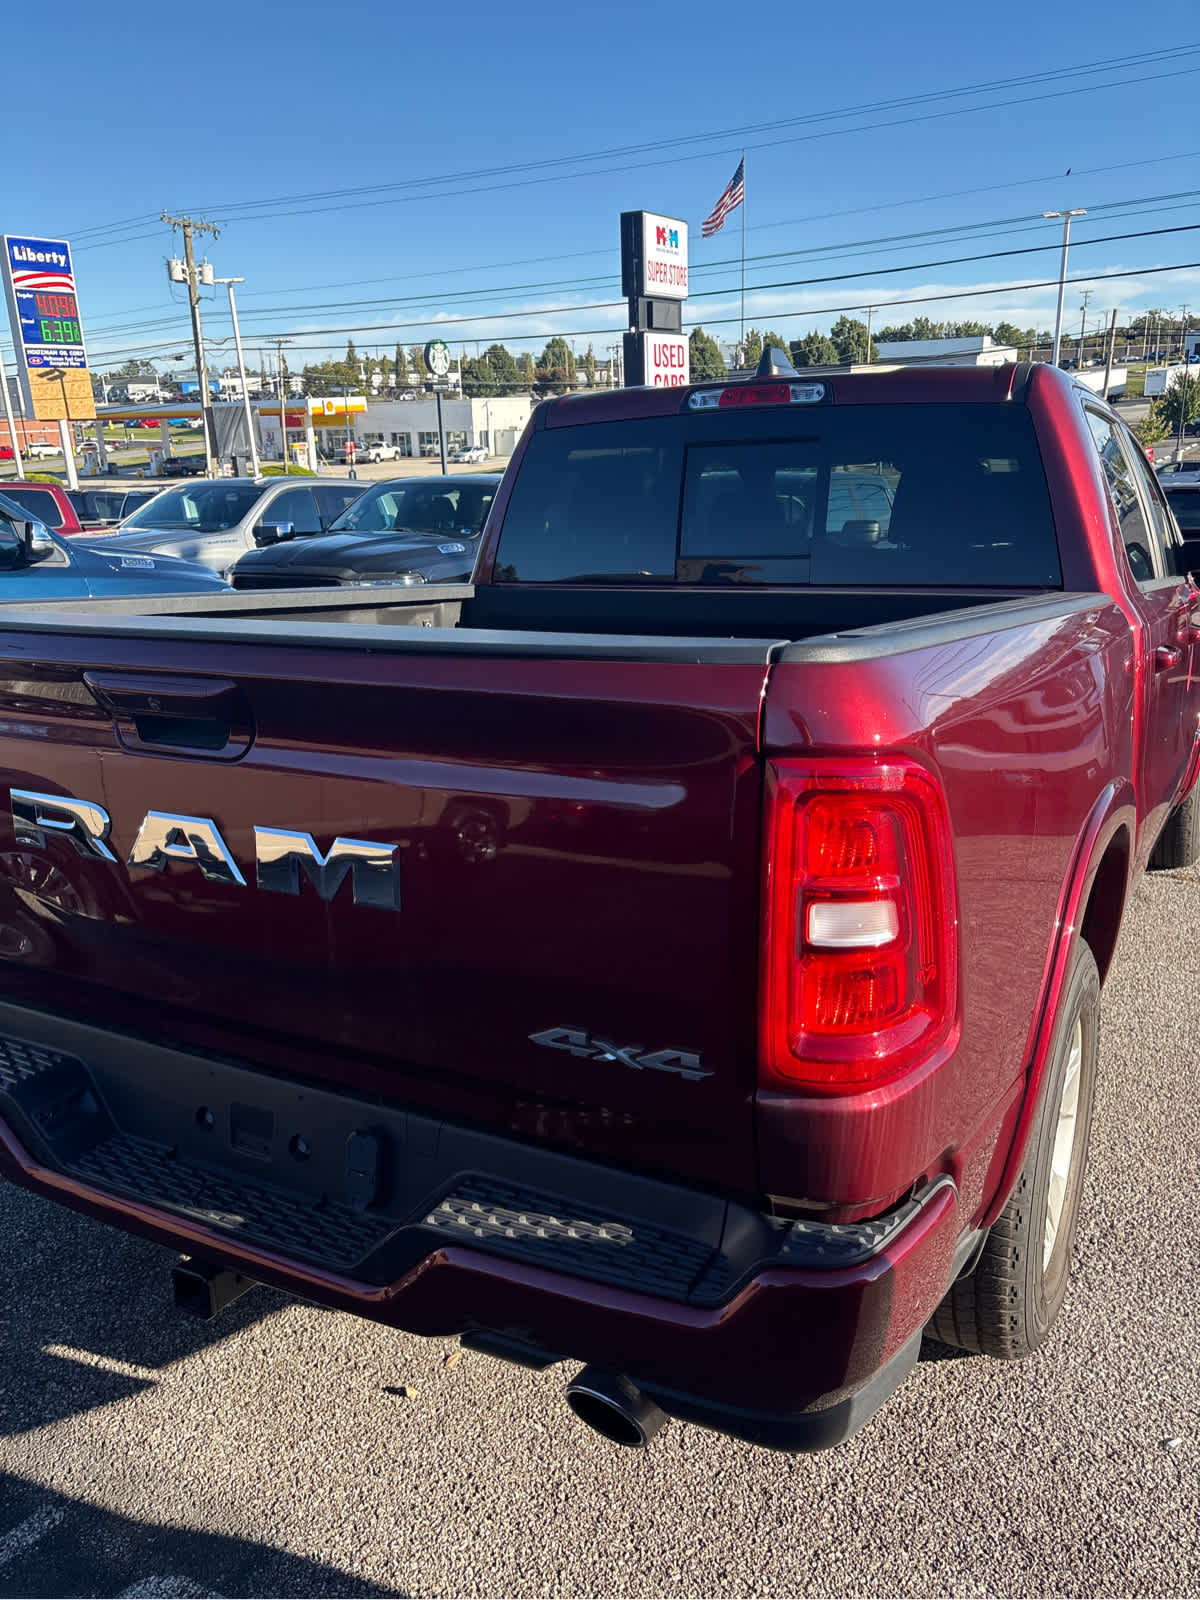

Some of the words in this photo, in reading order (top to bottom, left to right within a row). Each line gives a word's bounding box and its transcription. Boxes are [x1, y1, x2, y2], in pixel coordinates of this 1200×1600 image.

[13, 246, 67, 267] Liberty
[648, 260, 668, 283] SUPER
[669, 264, 687, 287] STORE
[653, 344, 685, 368] USED
[9, 788, 402, 912] RAM
